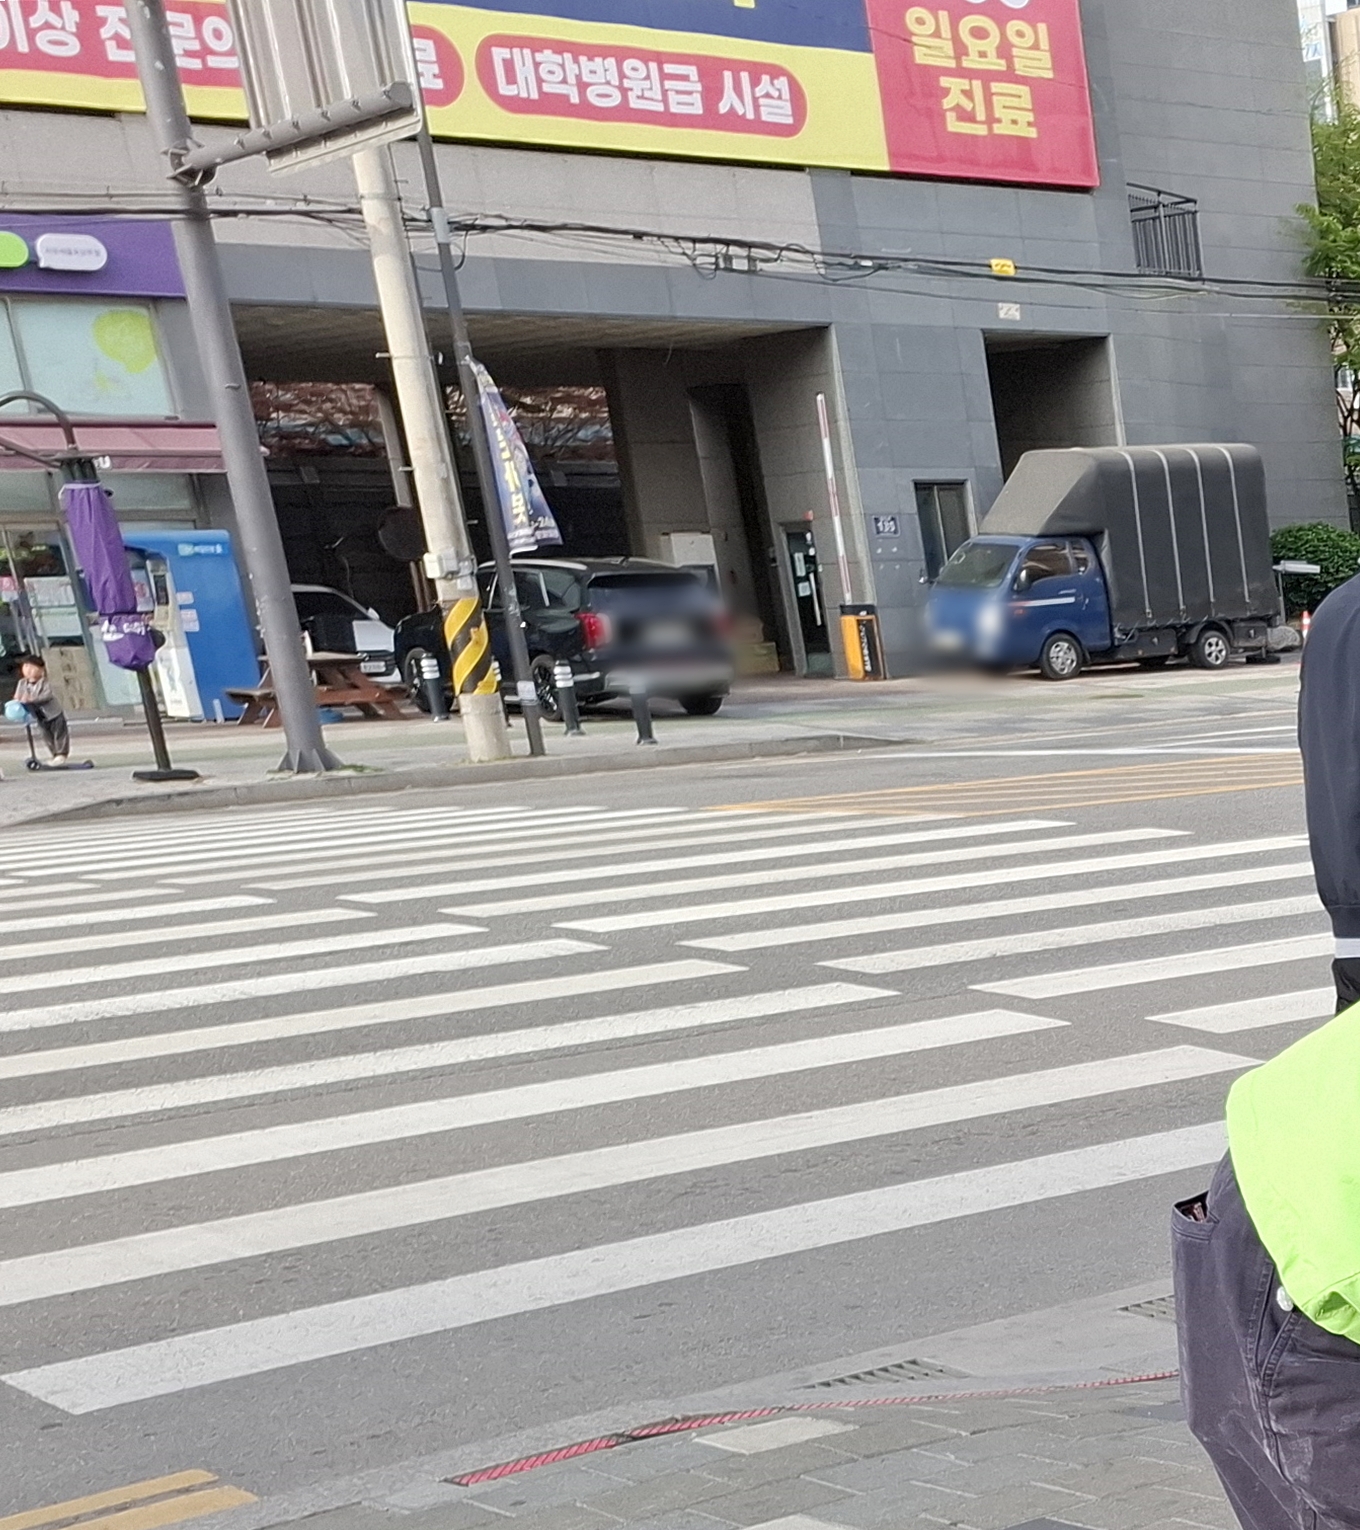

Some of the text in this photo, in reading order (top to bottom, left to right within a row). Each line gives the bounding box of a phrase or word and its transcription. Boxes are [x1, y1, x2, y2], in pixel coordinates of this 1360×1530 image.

[904, 6, 1054, 79] 일요일
[490, 46, 795, 126] 대학병원급 시설
[939, 76, 1039, 138] 진료
